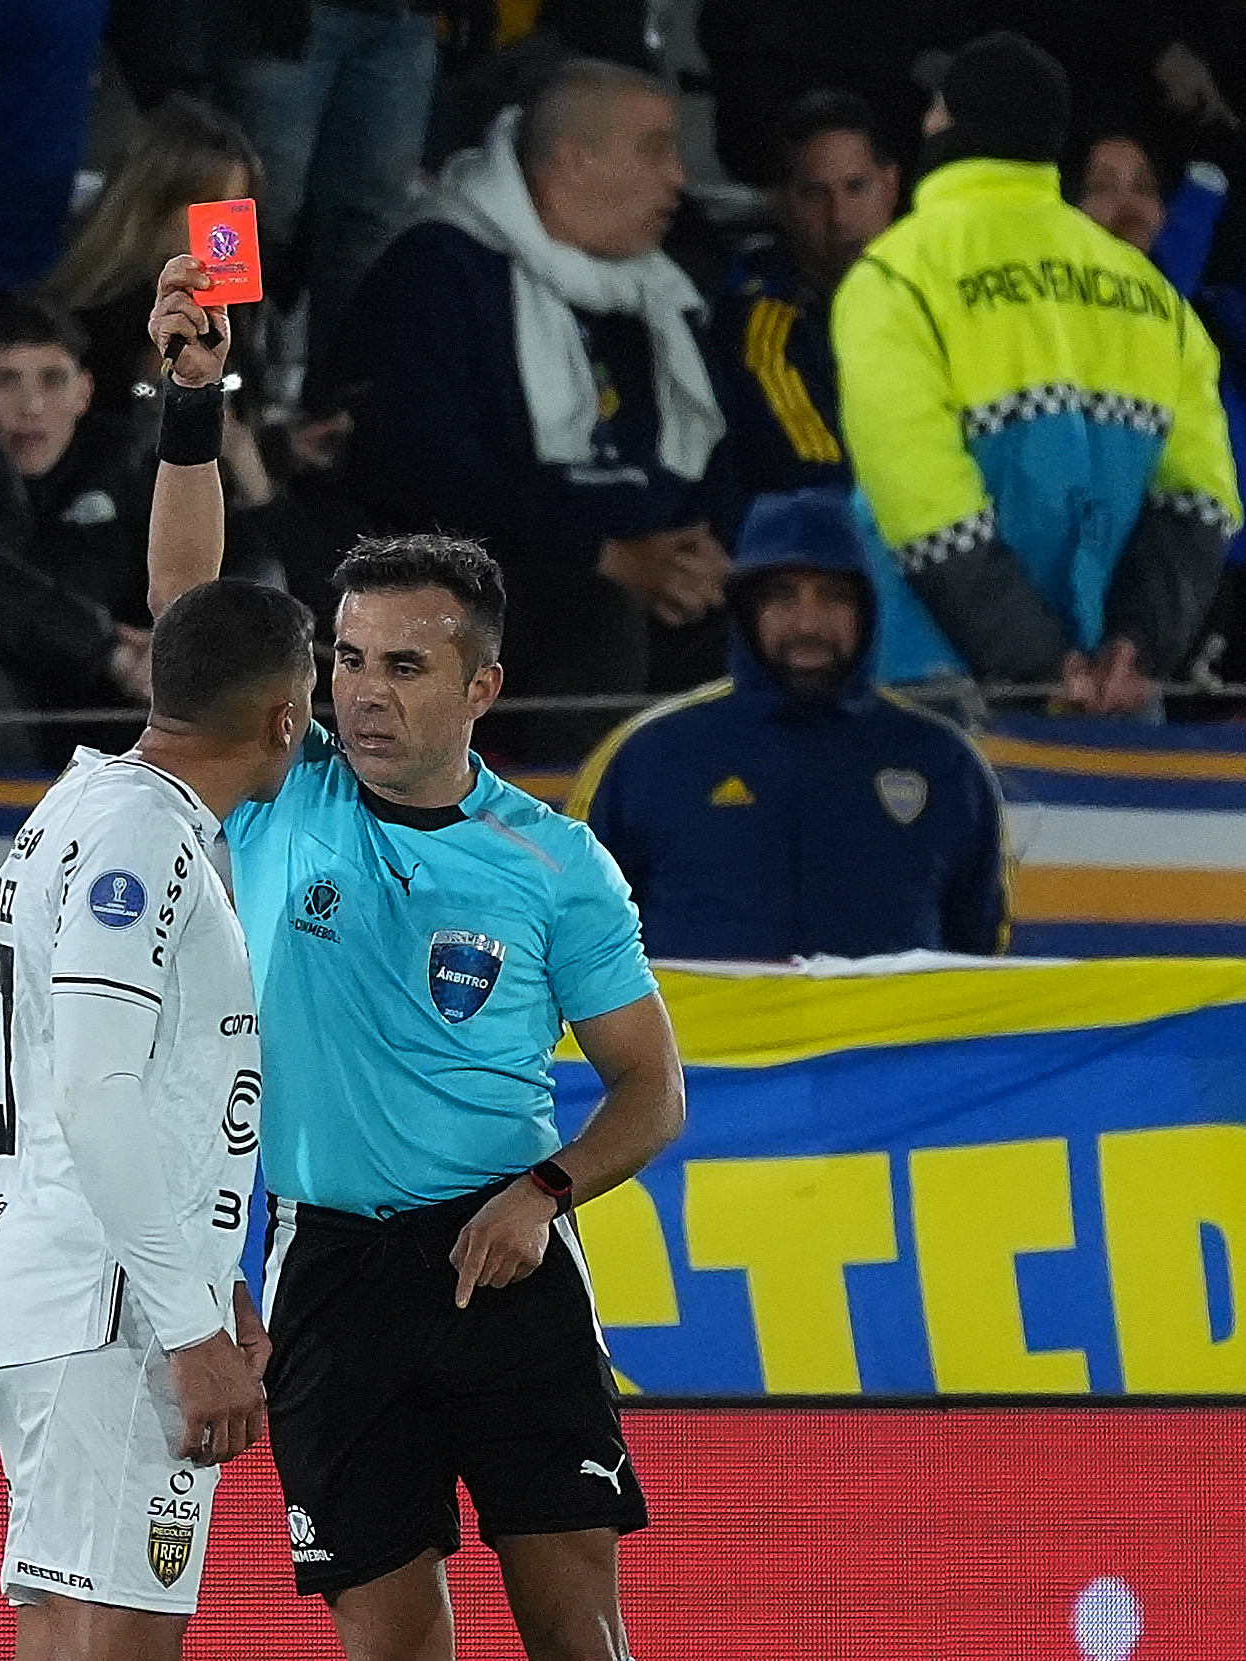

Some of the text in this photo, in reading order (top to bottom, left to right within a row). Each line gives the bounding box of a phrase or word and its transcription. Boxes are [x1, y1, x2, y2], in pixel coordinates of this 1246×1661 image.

[957, 257, 1170, 320] PREVENCION
[152, 842, 194, 967] nissei
[436, 966, 489, 989] ÁRBITRO
[147, 1497, 200, 1522] SASA
[153, 1526, 192, 1537] RECOLETA
[160, 1543, 183, 1560] RFC
[17, 1561, 94, 1591] RECOLETA
